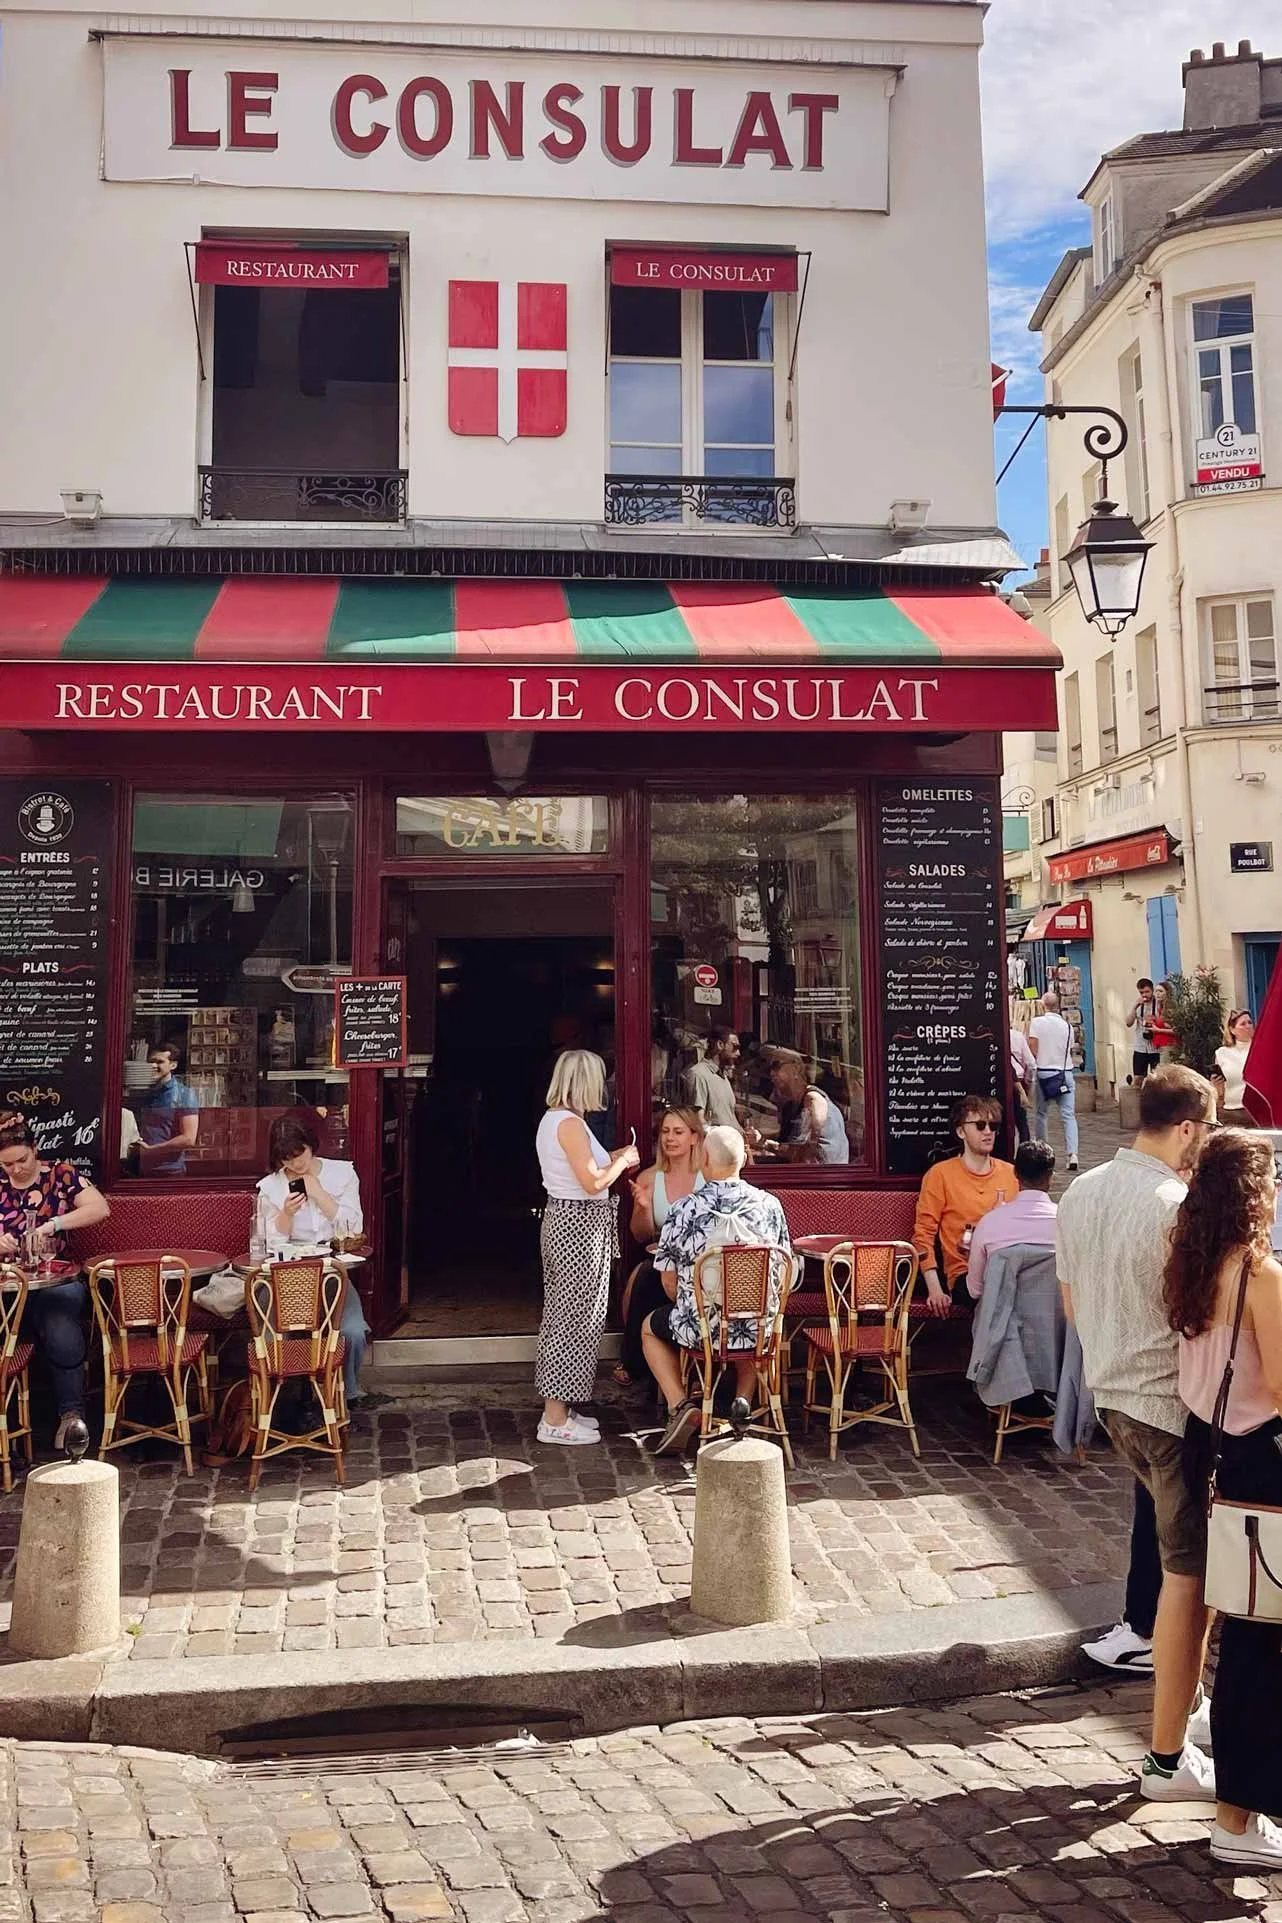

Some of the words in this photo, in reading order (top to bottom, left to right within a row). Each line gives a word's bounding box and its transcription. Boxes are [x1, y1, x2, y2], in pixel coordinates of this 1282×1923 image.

[167, 69, 279, 152] LE
[329, 73, 839, 172] CONSULAT
[227, 260, 359, 279] RESTAURANT
[636, 262, 661, 278] LE
[669, 264, 776, 282] CONSULAT
[1222, 432, 1234, 442] 21
[1200, 448, 1246, 460] CENTURY
[1248, 447, 1257, 455] 21
[1210, 467, 1250, 480] VENDU
[1200, 480, 1258, 494] 01.44.92.75.21
[54, 683, 383, 720] RESTAURANT
[507, 678, 583, 720] LE
[614, 678, 939, 721] CONSULAT
[902, 789, 973, 801] OMELETTES
[21, 795, 46, 816] Bistrot
[54, 797, 72, 814] Café
[20, 852, 70, 863] ENTRÉES
[909, 864, 966, 877] SALADES
[38, 880, 77, 890] Bourgogne
[883, 880, 906, 889] Salade
[38, 893, 76, 902] Bourgogne
[884, 900, 906, 908] Salade
[884, 918, 908, 926] Salade
[884, 938, 907, 947] Salade
[22, 962, 60, 974] PLATS
[886, 970, 908, 982] Croque
[340, 983, 354, 992] LES
[378, 982, 402, 991] CARTE
[886, 982, 909, 992] Croque
[887, 992, 909, 1002] Croque
[916, 1024, 967, 1038] CRÊPES
[360, 1041, 381, 1052] frites
[27, 1110, 76, 1137] tipasti
[37, 1134, 64, 1151] lat
